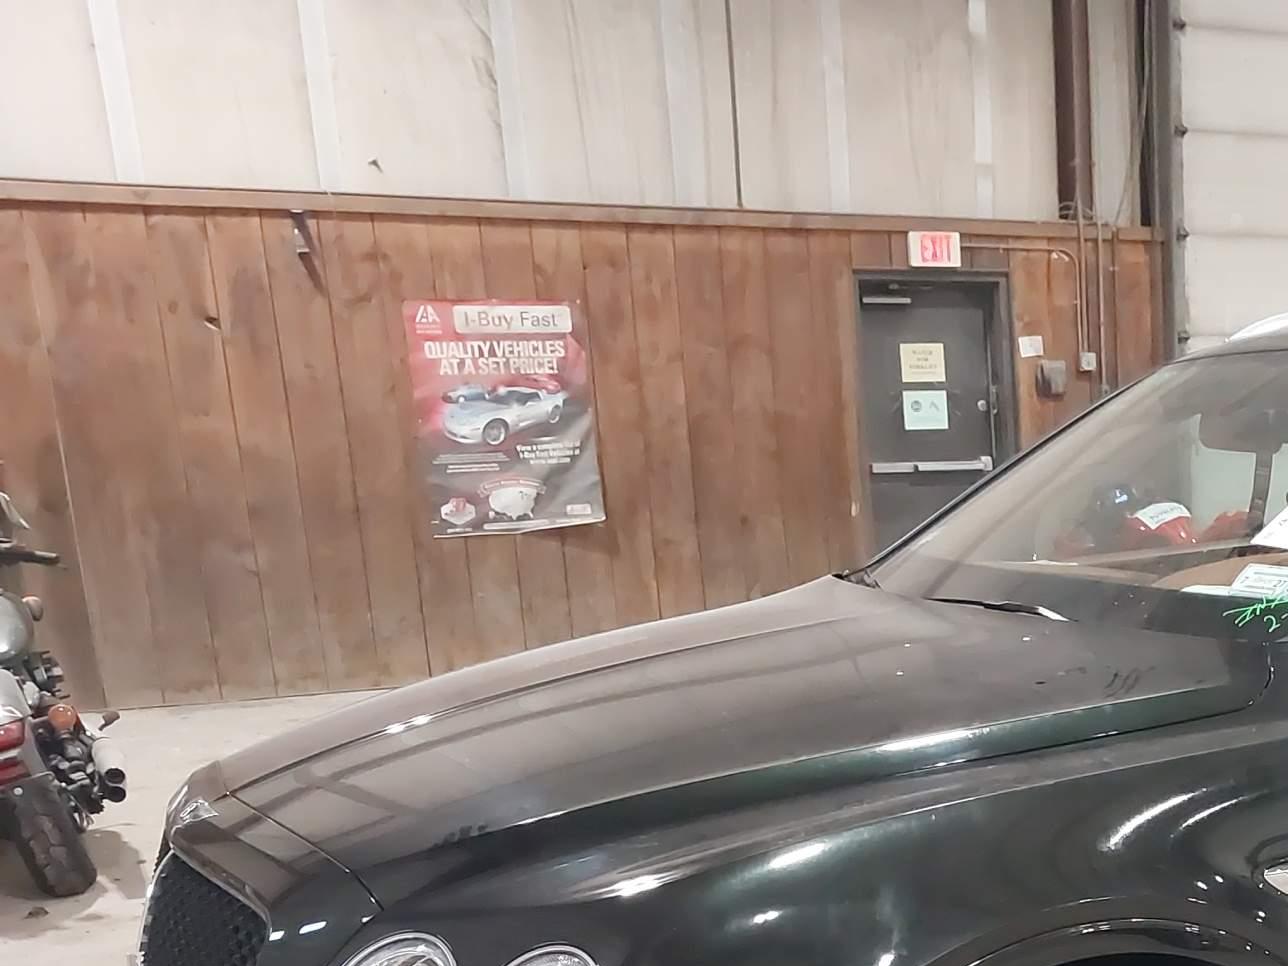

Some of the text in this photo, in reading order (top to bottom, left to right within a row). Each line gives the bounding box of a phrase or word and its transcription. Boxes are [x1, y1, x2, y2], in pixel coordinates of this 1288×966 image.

[921, 234, 951, 263] EXIT
[464, 311, 557, 330] I-Buy Fast
[424, 340, 566, 358] QUALITY VEHICLES
[440, 357, 559, 375] AT A SET PRICE!
